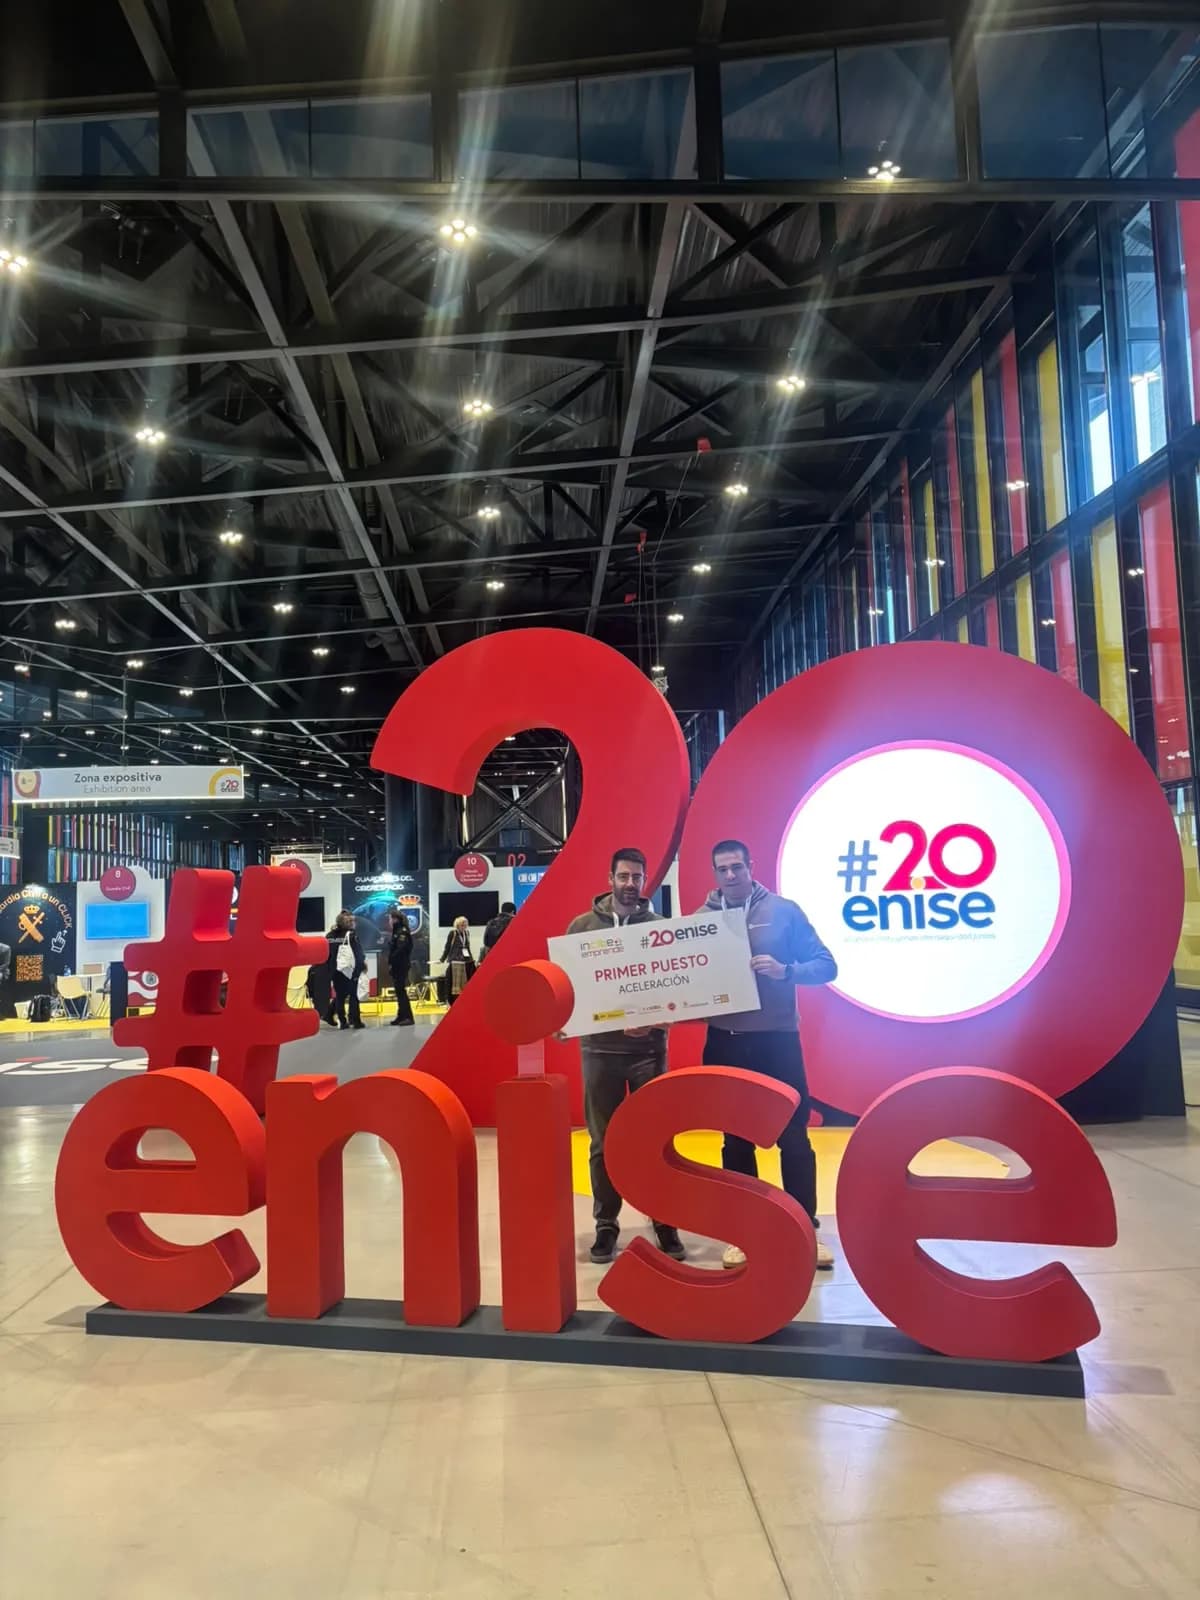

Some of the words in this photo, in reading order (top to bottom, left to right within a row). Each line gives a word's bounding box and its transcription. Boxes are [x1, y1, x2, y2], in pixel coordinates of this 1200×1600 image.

[74, 773, 100, 784] Zona
[103, 772, 162, 785] expositiva
[83, 784, 128, 794] Exhibition
[130, 786, 151, 794] area
[466, 857, 477, 866] 10
[115, 870, 121, 879] 8
[48, 895, 60, 907] un
[58, 904, 73, 929] CLICK
[842, 878, 996, 932] enise
[594, 962, 647, 983] PRIMER
[650, 953, 709, 974] PUESTO
[618, 975, 690, 995] ACELERACIÓN
[56, 960, 1118, 1362] enise
